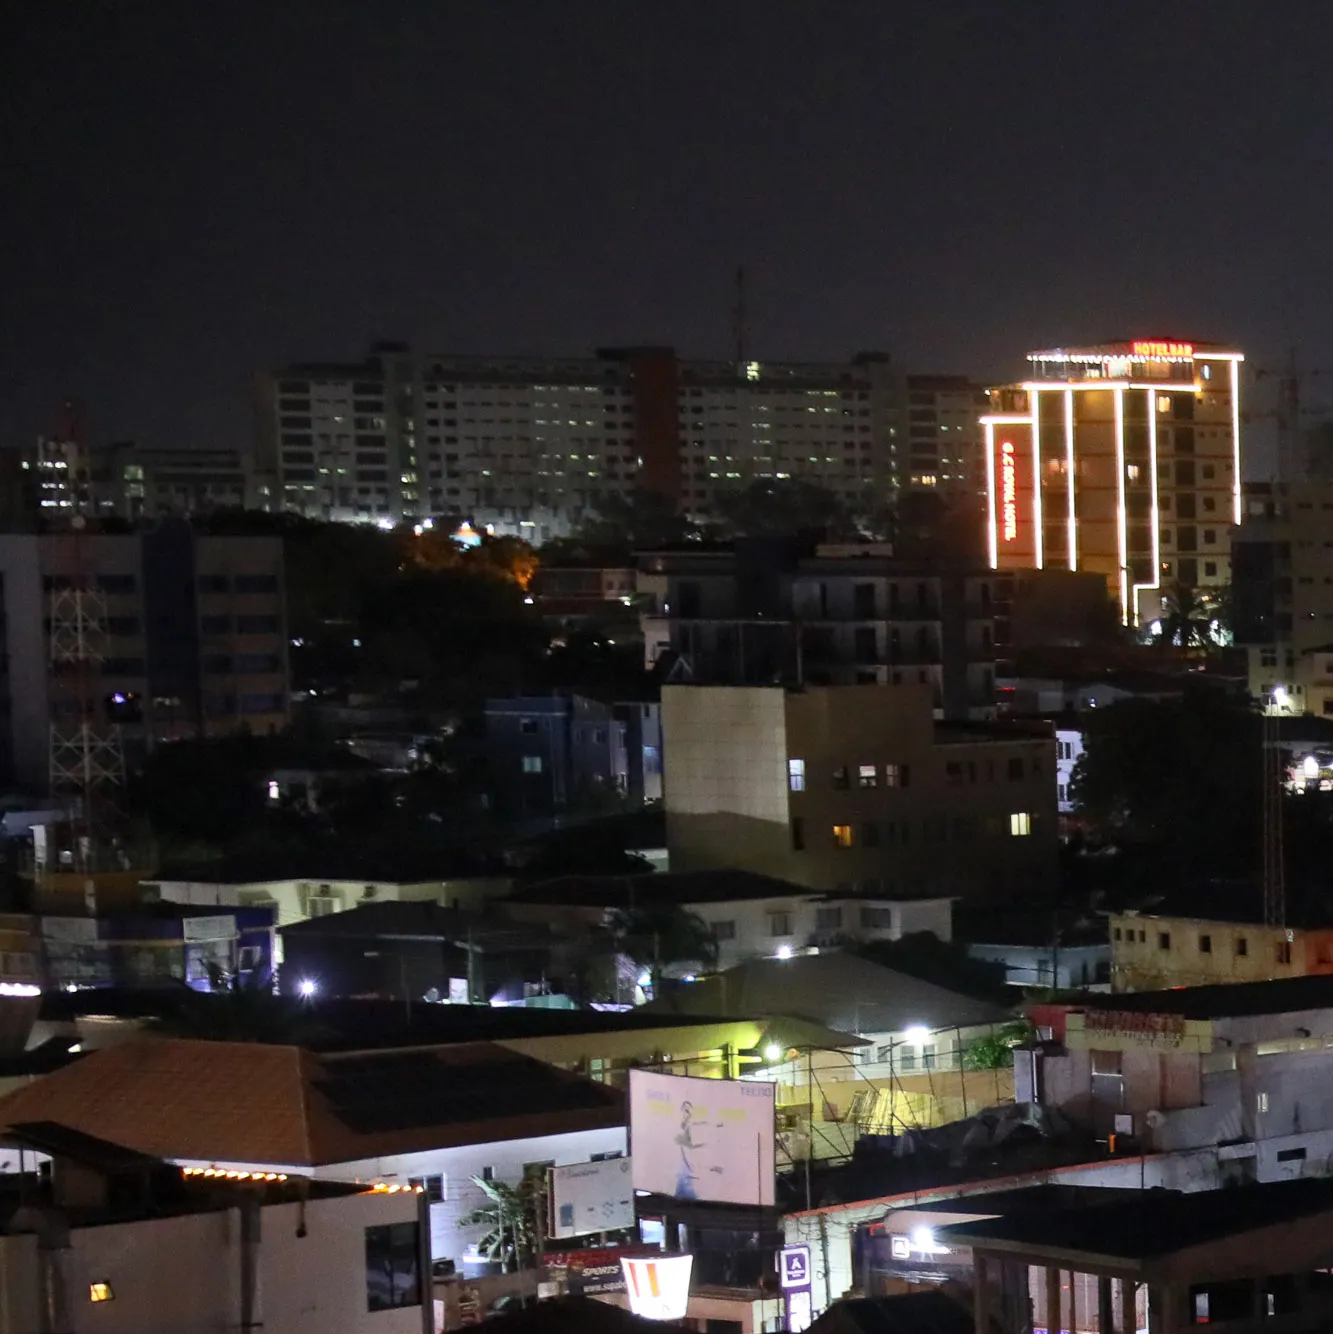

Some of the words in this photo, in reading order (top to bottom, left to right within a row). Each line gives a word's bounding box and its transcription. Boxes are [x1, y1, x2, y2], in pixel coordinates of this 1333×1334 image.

[1133, 342, 1168, 356] HOTEL
[1004, 503, 1017, 541] HOTEL
[582, 1265, 620, 1277] SPORTS
